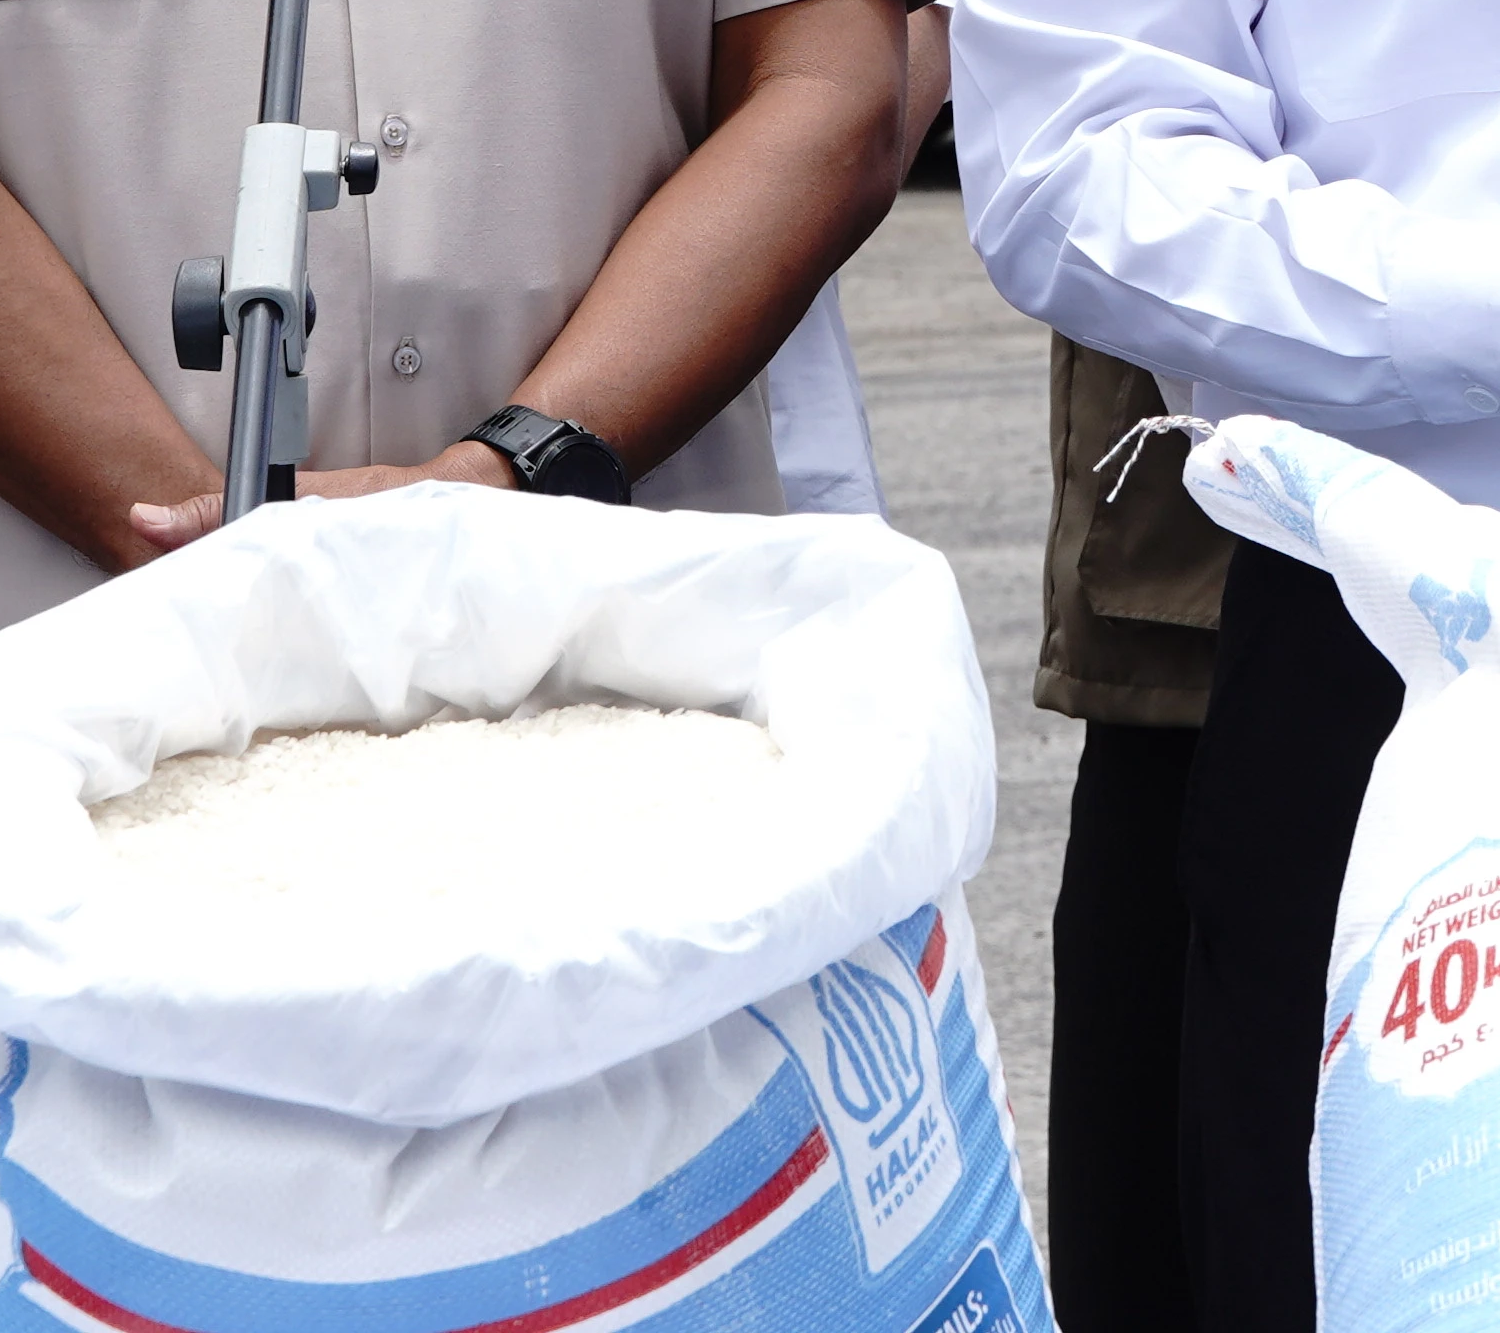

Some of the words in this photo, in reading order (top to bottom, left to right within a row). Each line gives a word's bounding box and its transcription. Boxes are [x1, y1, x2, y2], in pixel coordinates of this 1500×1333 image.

[1401, 922, 1441, 958] NET
[866, 1105, 938, 1207] HALAL
[875, 1134, 947, 1228] INDONESIA
